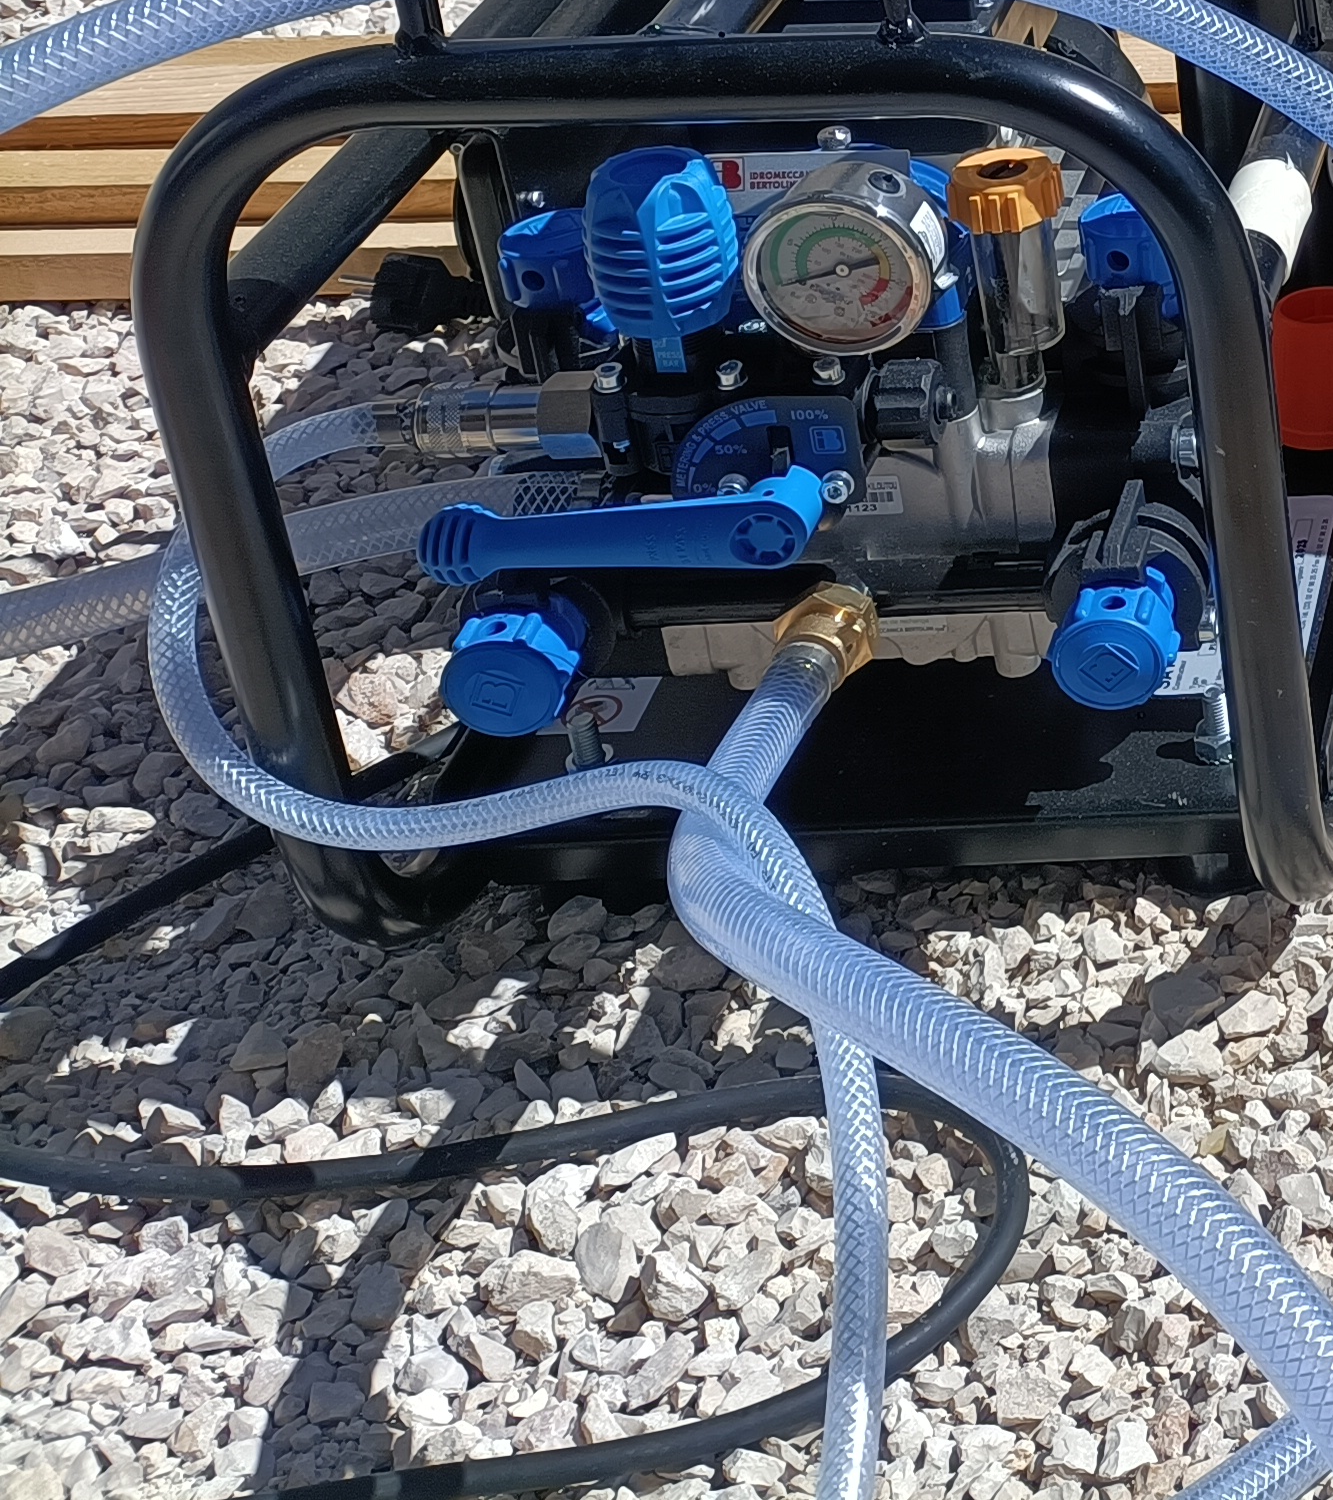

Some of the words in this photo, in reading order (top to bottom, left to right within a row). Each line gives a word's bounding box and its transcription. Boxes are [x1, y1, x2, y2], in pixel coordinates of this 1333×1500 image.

[790, 409, 829, 421] 100%
[676, 440, 697, 488] METERING
[731, 400, 768, 416] VALVE
[715, 444, 748, 456] 50%
[692, 482, 718, 494] 0%
